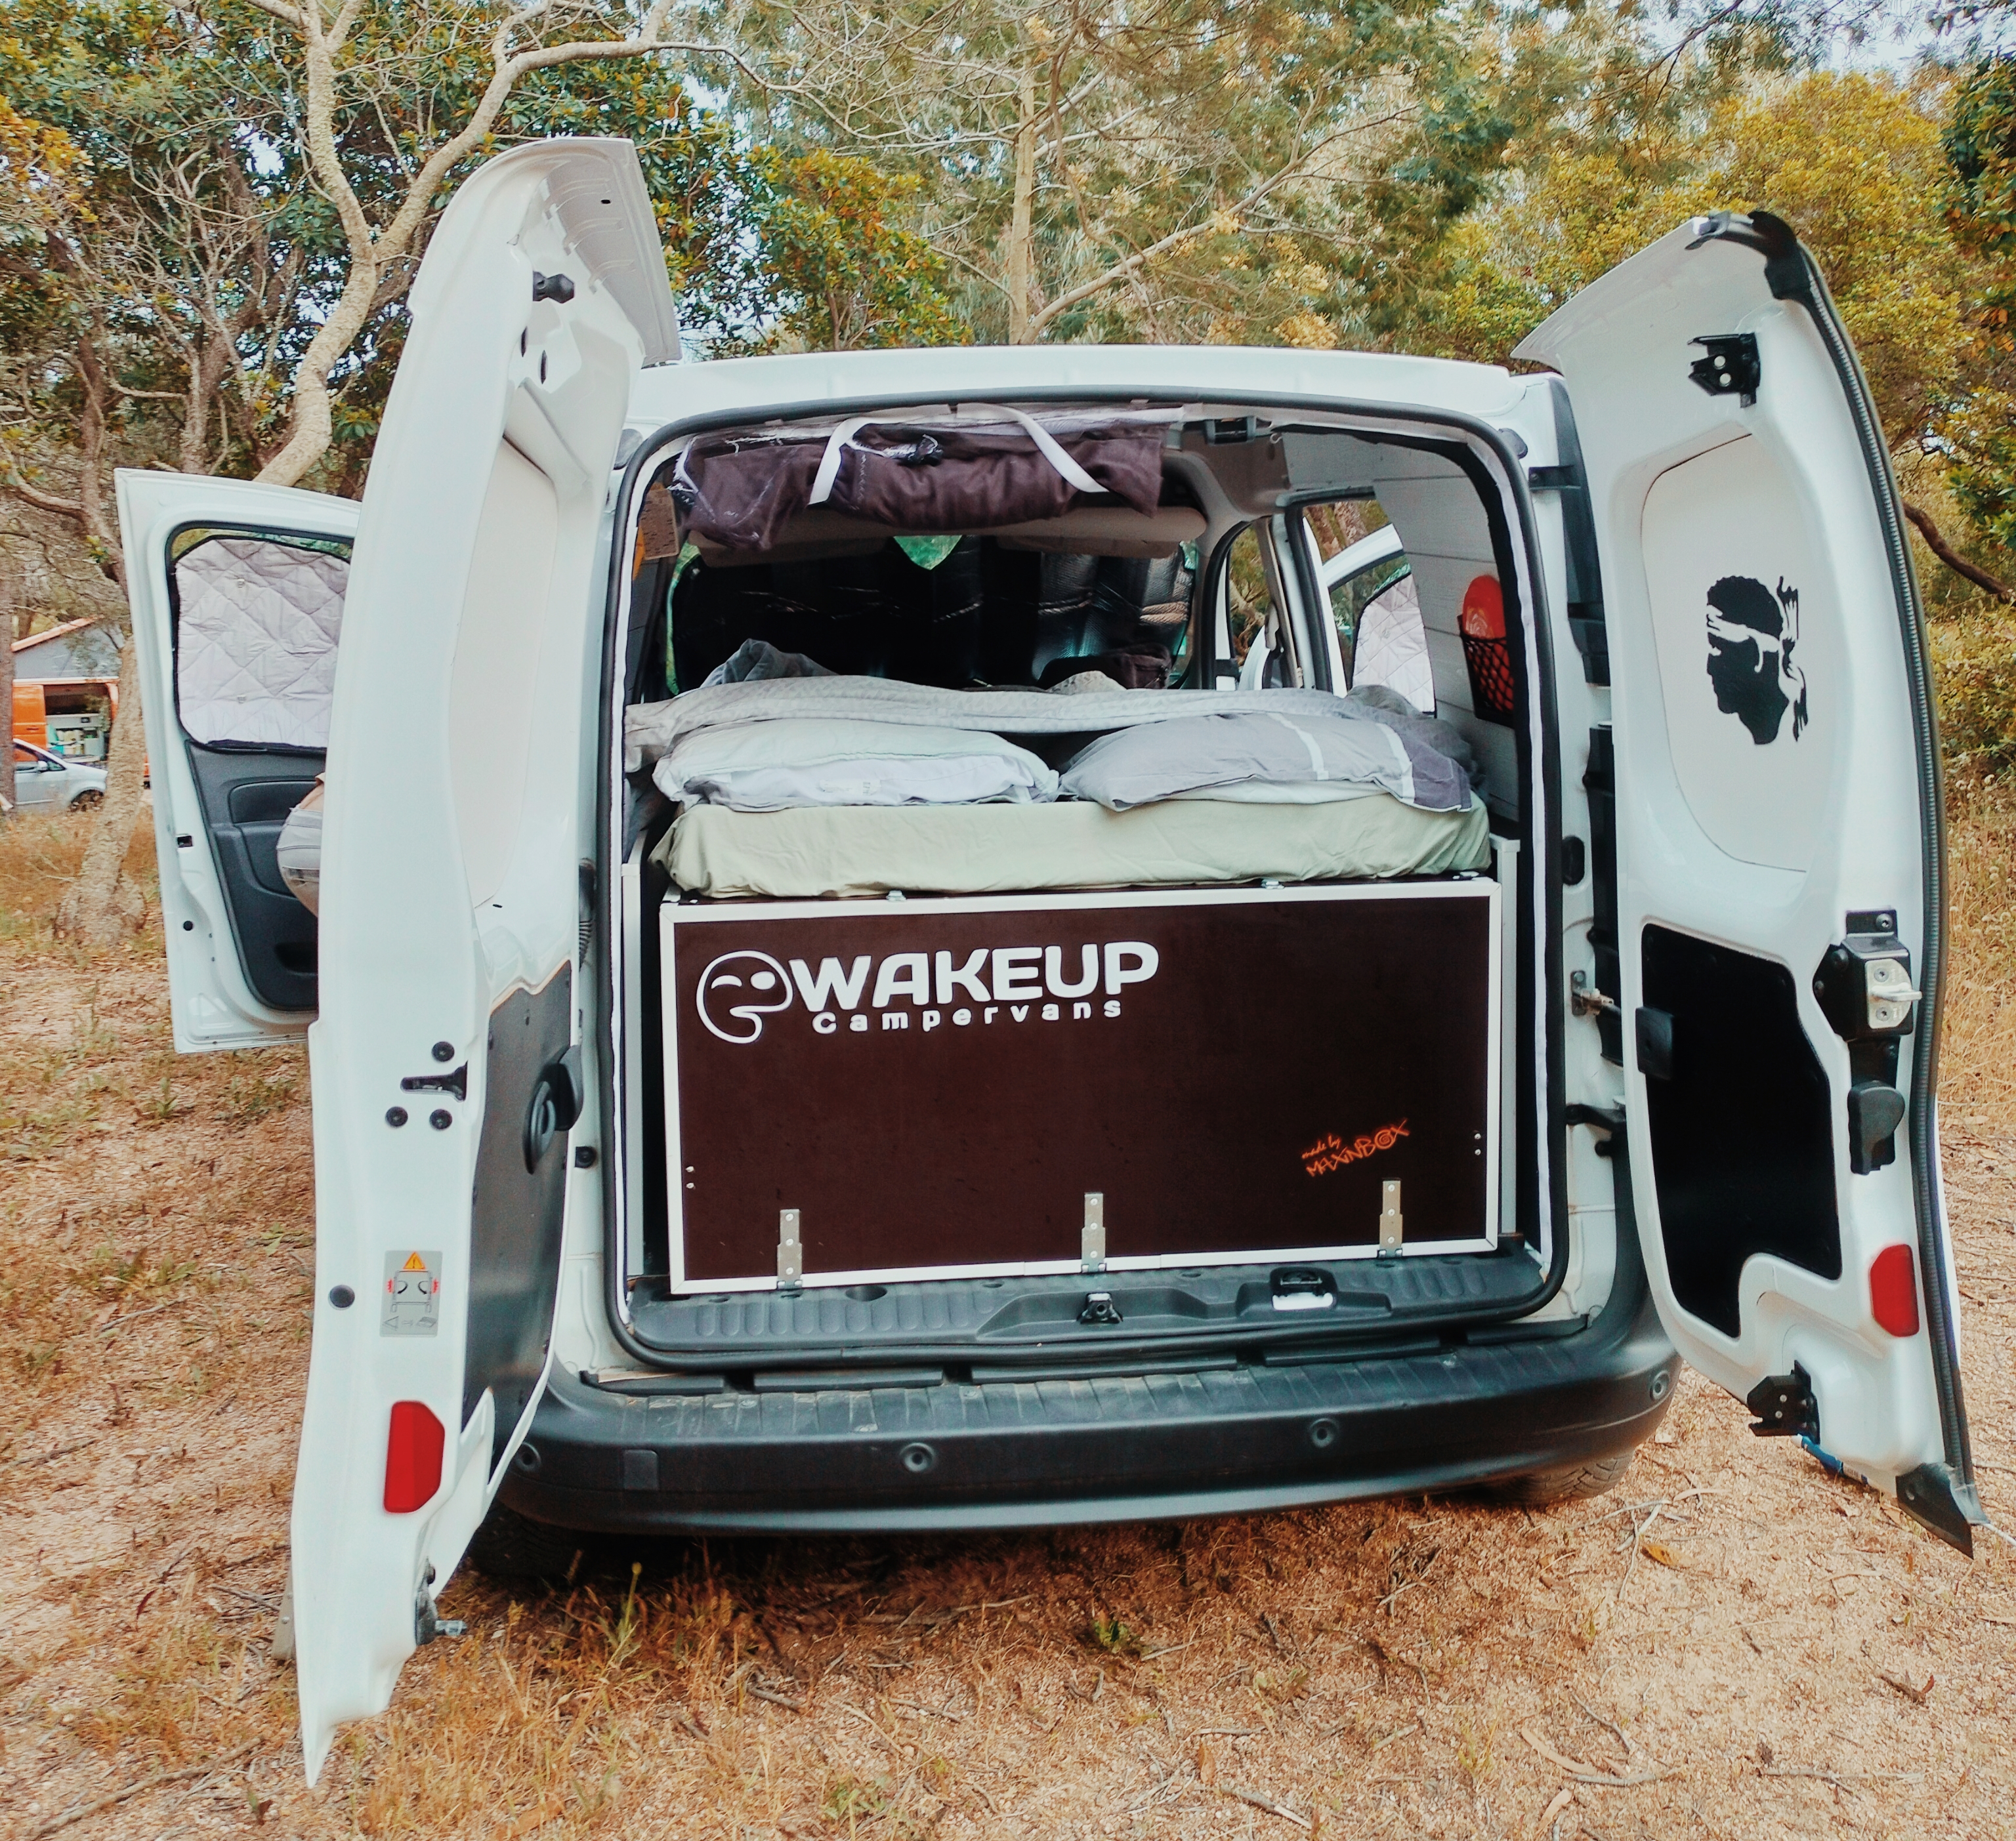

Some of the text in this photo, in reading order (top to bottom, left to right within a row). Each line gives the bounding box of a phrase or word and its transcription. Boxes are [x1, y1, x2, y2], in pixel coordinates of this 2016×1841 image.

[788, 941, 1159, 1012] WAKEUP
[1301, 1134, 1341, 1159] made by
